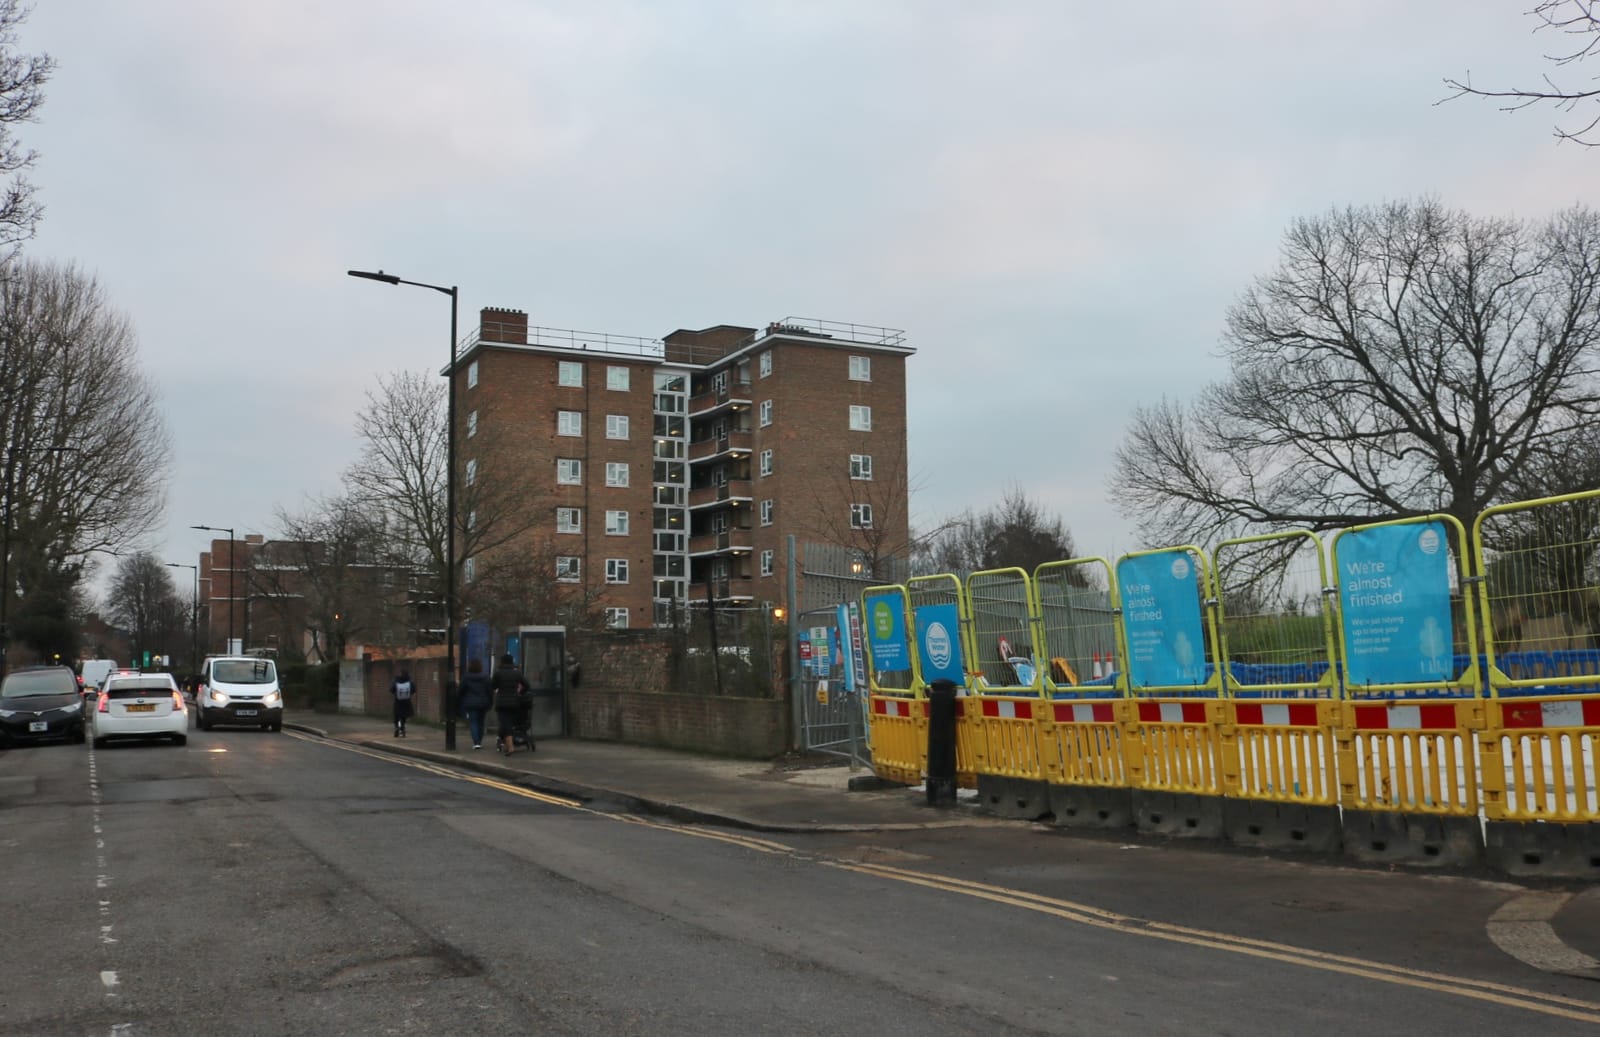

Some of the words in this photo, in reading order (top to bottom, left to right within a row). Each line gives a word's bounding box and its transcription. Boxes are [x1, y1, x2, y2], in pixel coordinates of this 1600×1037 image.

[1346, 561, 1385, 576] We're
[1348, 576, 1393, 592] almost
[1350, 589, 1403, 608] finished
